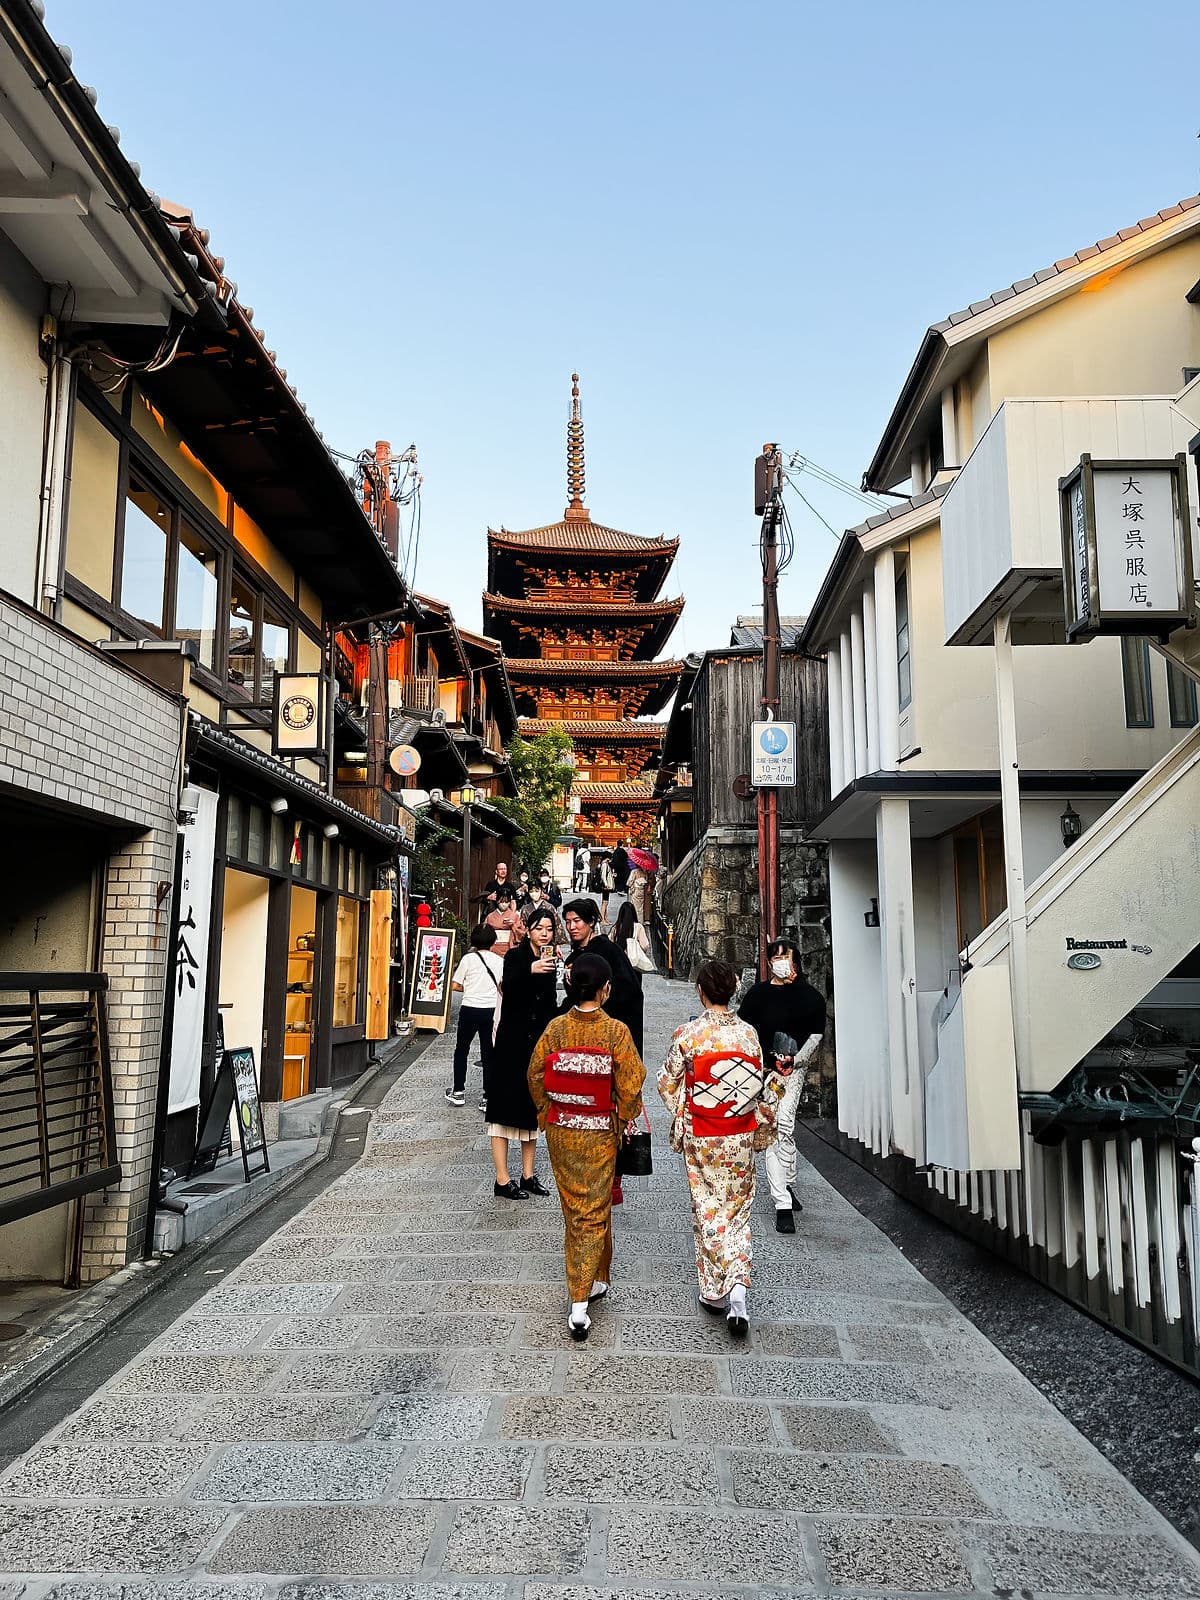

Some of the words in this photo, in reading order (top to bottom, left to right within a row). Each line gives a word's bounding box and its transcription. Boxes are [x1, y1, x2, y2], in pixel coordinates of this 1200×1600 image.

[1122, 476, 1148, 604] 大塚呉服店
[762, 765, 787, 773] 10-17
[1066, 937, 1127, 950] Restaurant
